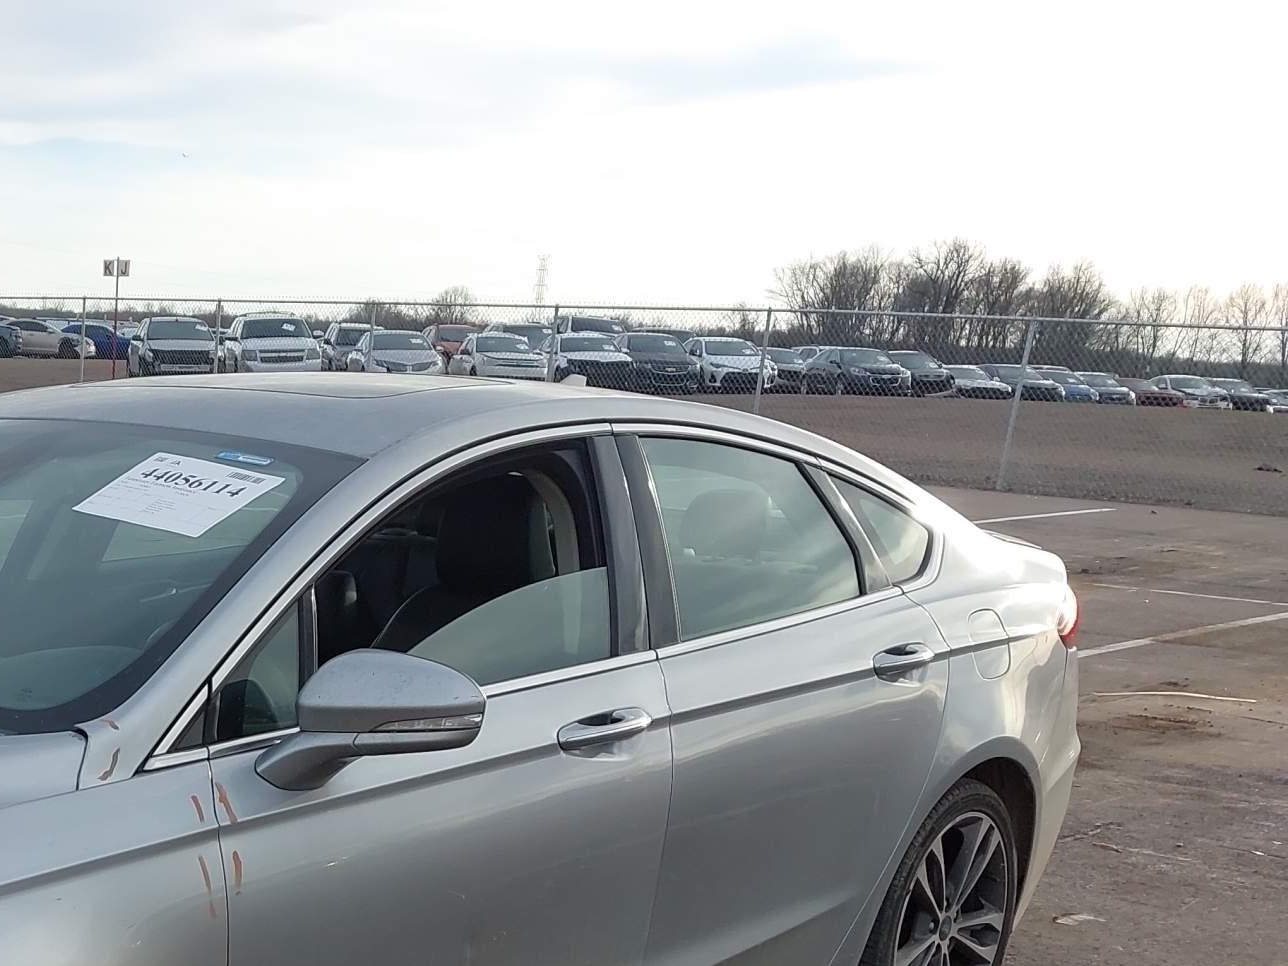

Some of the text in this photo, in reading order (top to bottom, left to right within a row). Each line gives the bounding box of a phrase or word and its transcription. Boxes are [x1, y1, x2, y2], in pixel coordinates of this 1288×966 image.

[104, 261, 113, 274] K
[120, 261, 128, 275] J
[140, 467, 248, 498] 44056114
